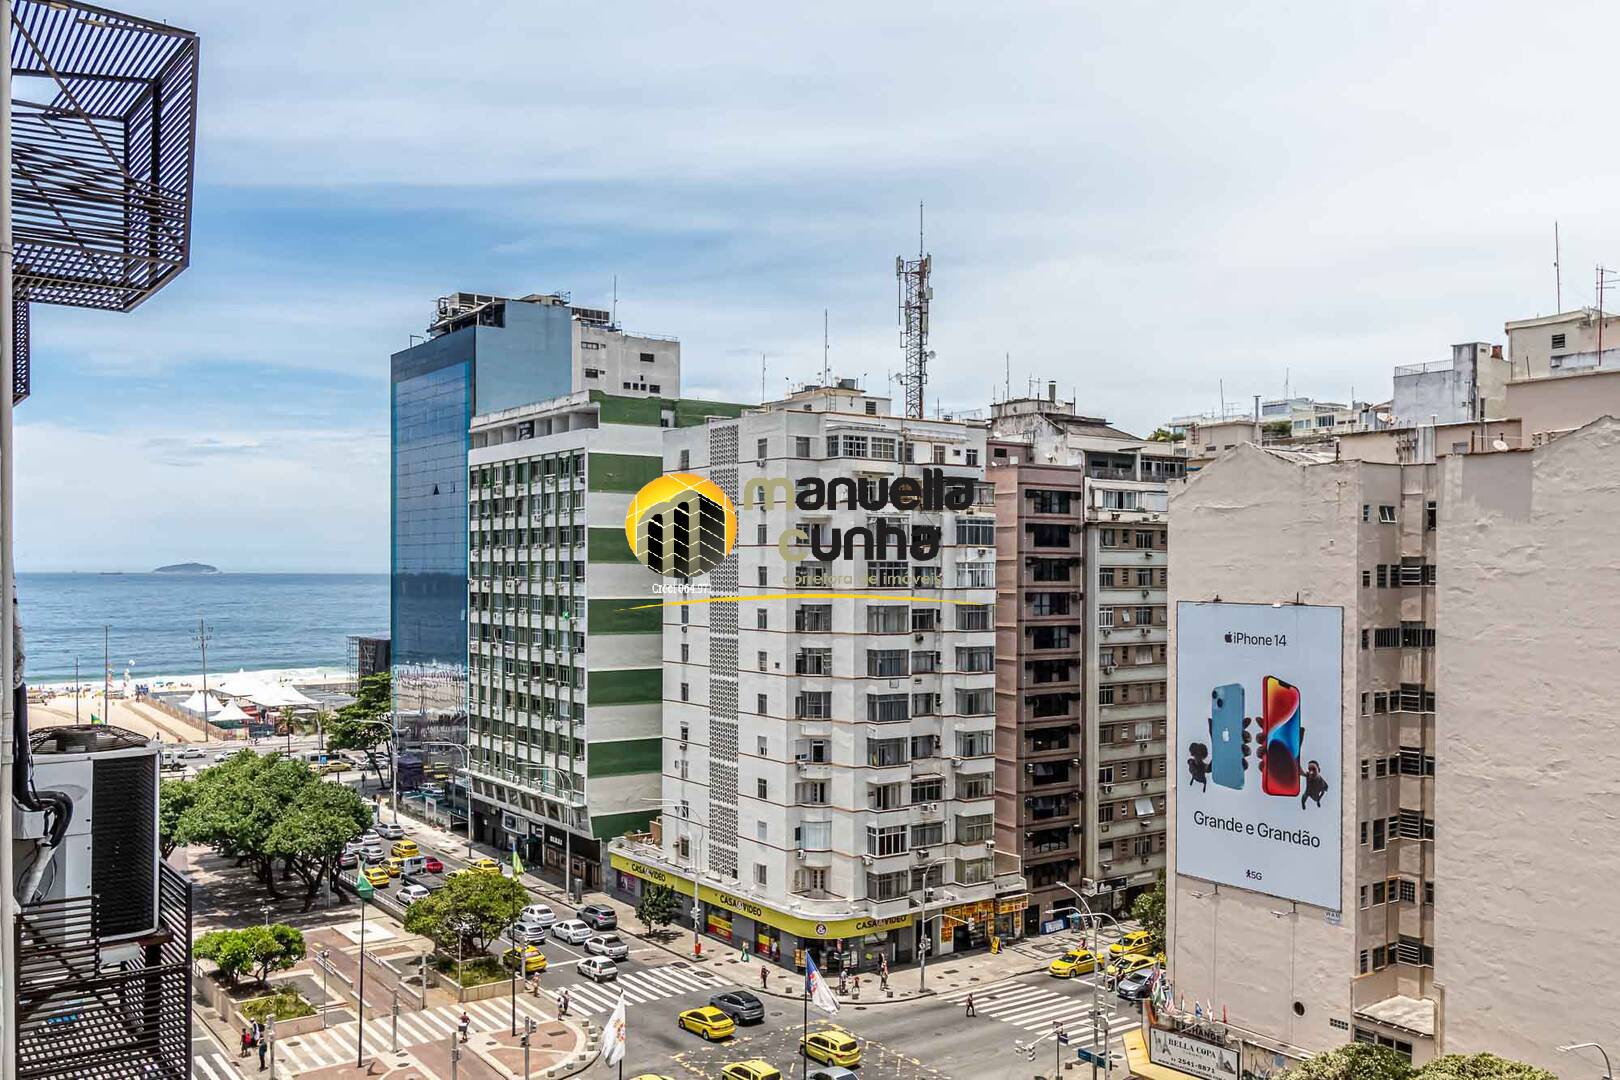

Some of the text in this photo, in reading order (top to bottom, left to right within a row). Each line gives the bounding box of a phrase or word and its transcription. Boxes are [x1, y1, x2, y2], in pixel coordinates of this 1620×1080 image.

[1233, 632, 1287, 646] iPhone 14
[1194, 811, 1321, 848] Grande e Grandão
[1251, 871, 1262, 880] 5G
[1168, 1038, 1195, 1052] BELLA
[1196, 1047, 1217, 1059] COPA
